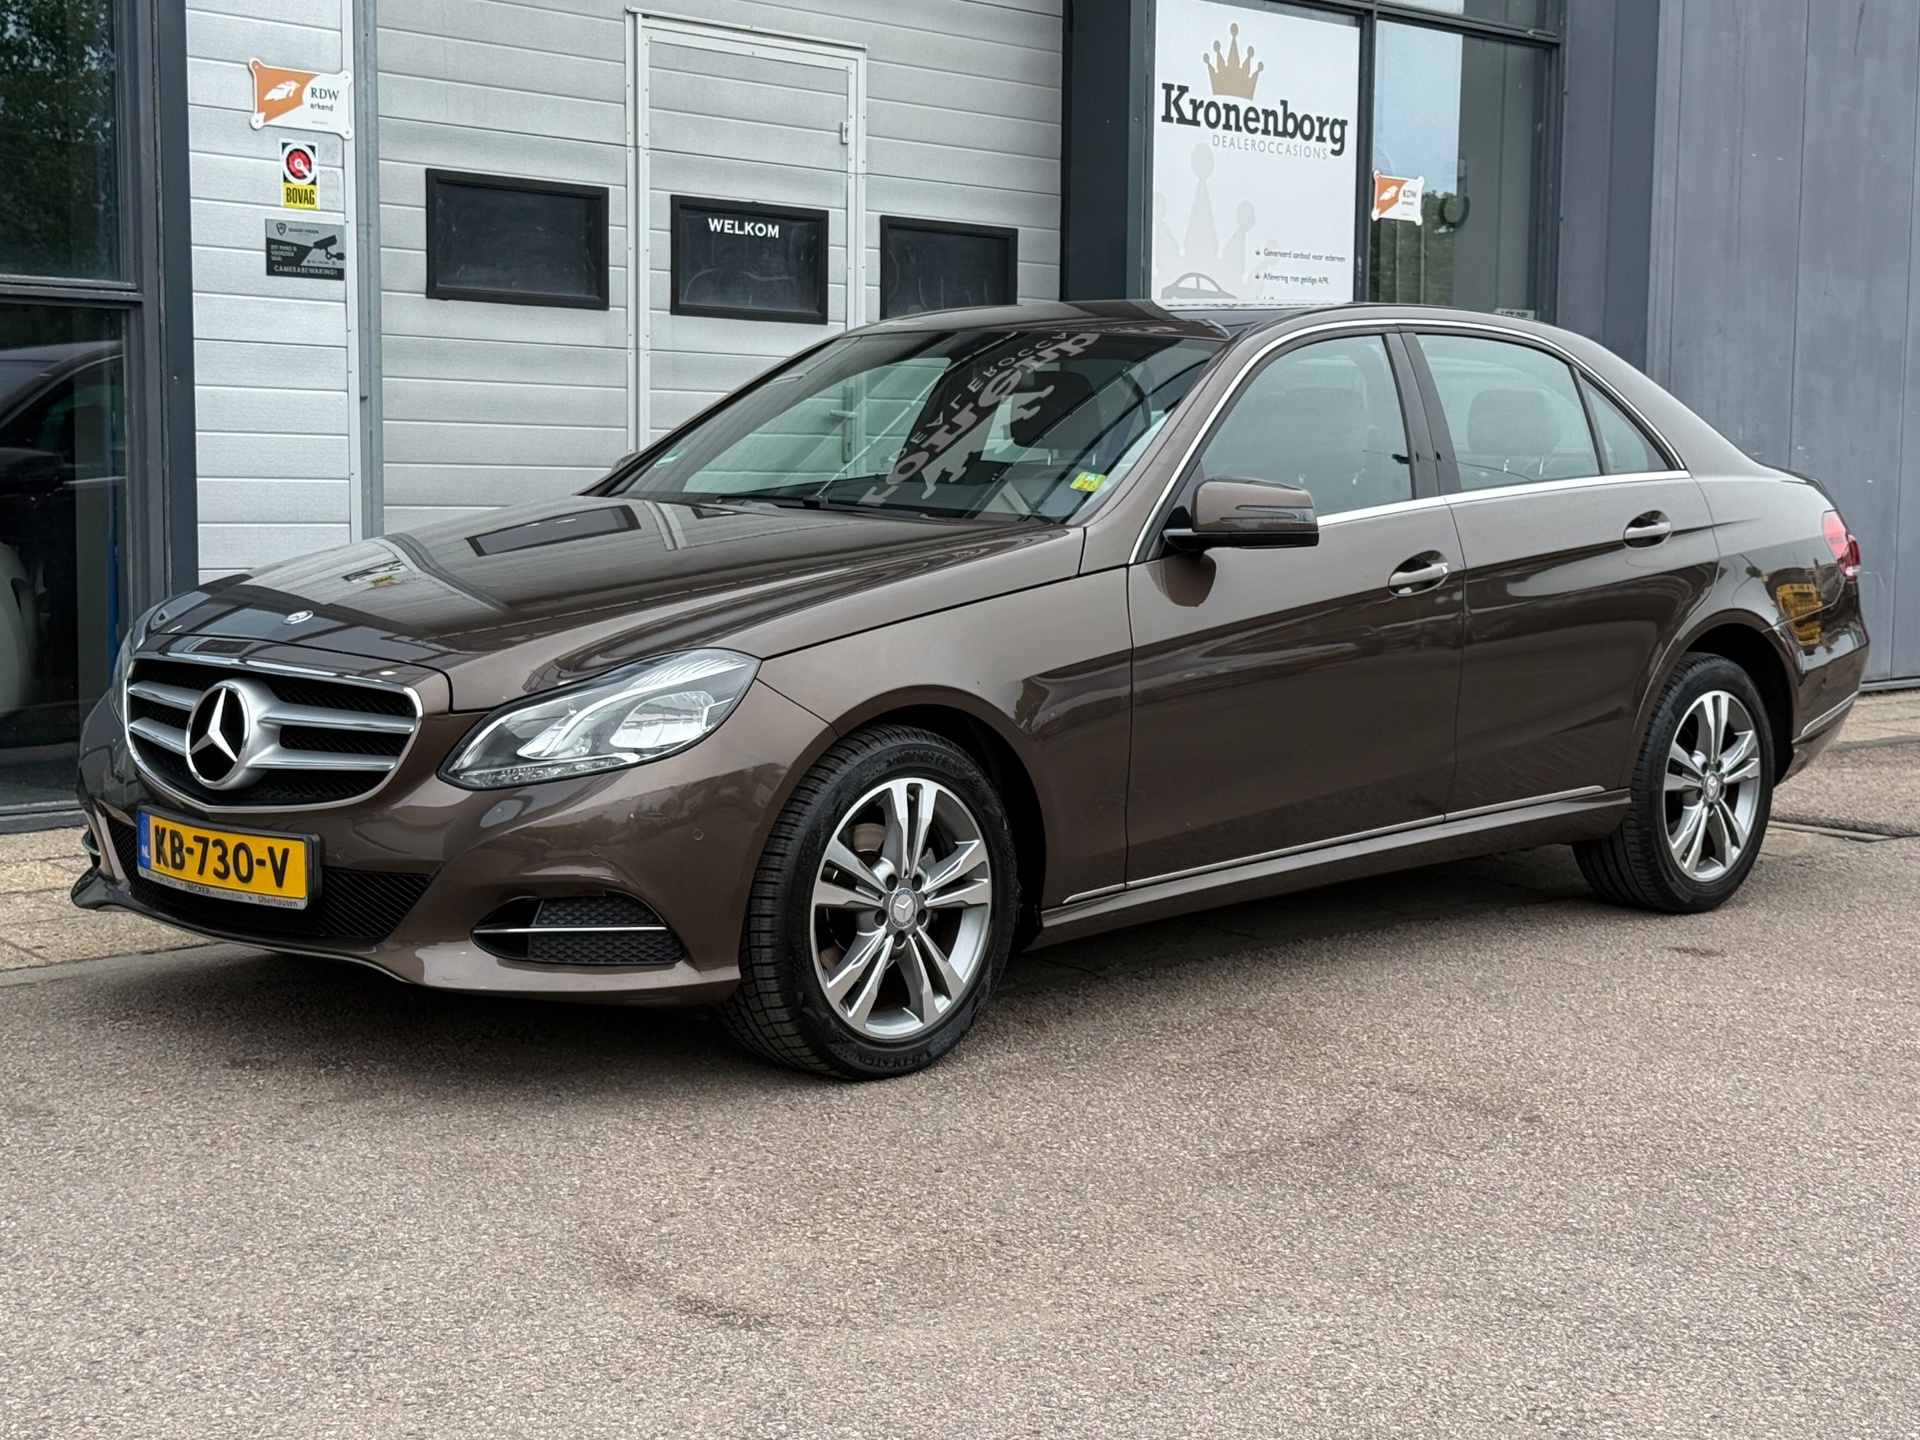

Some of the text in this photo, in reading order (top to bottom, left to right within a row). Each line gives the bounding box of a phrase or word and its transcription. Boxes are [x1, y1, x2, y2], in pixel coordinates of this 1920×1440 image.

[310, 87, 340, 101] RDW
[310, 102, 334, 112] erkend
[1161, 82, 1348, 156] Kronenborg
[1212, 134, 1328, 160] DEALEROCCASIONS
[285, 186, 316, 205] BOVAG
[707, 217, 780, 239] WELKOM
[273, 265, 338, 276] CAMERABEWAKING!
[141, 843, 151, 859] NL
[154, 825, 290, 889] KB-730-V
[257, 894, 298, 908] Oberhausen
